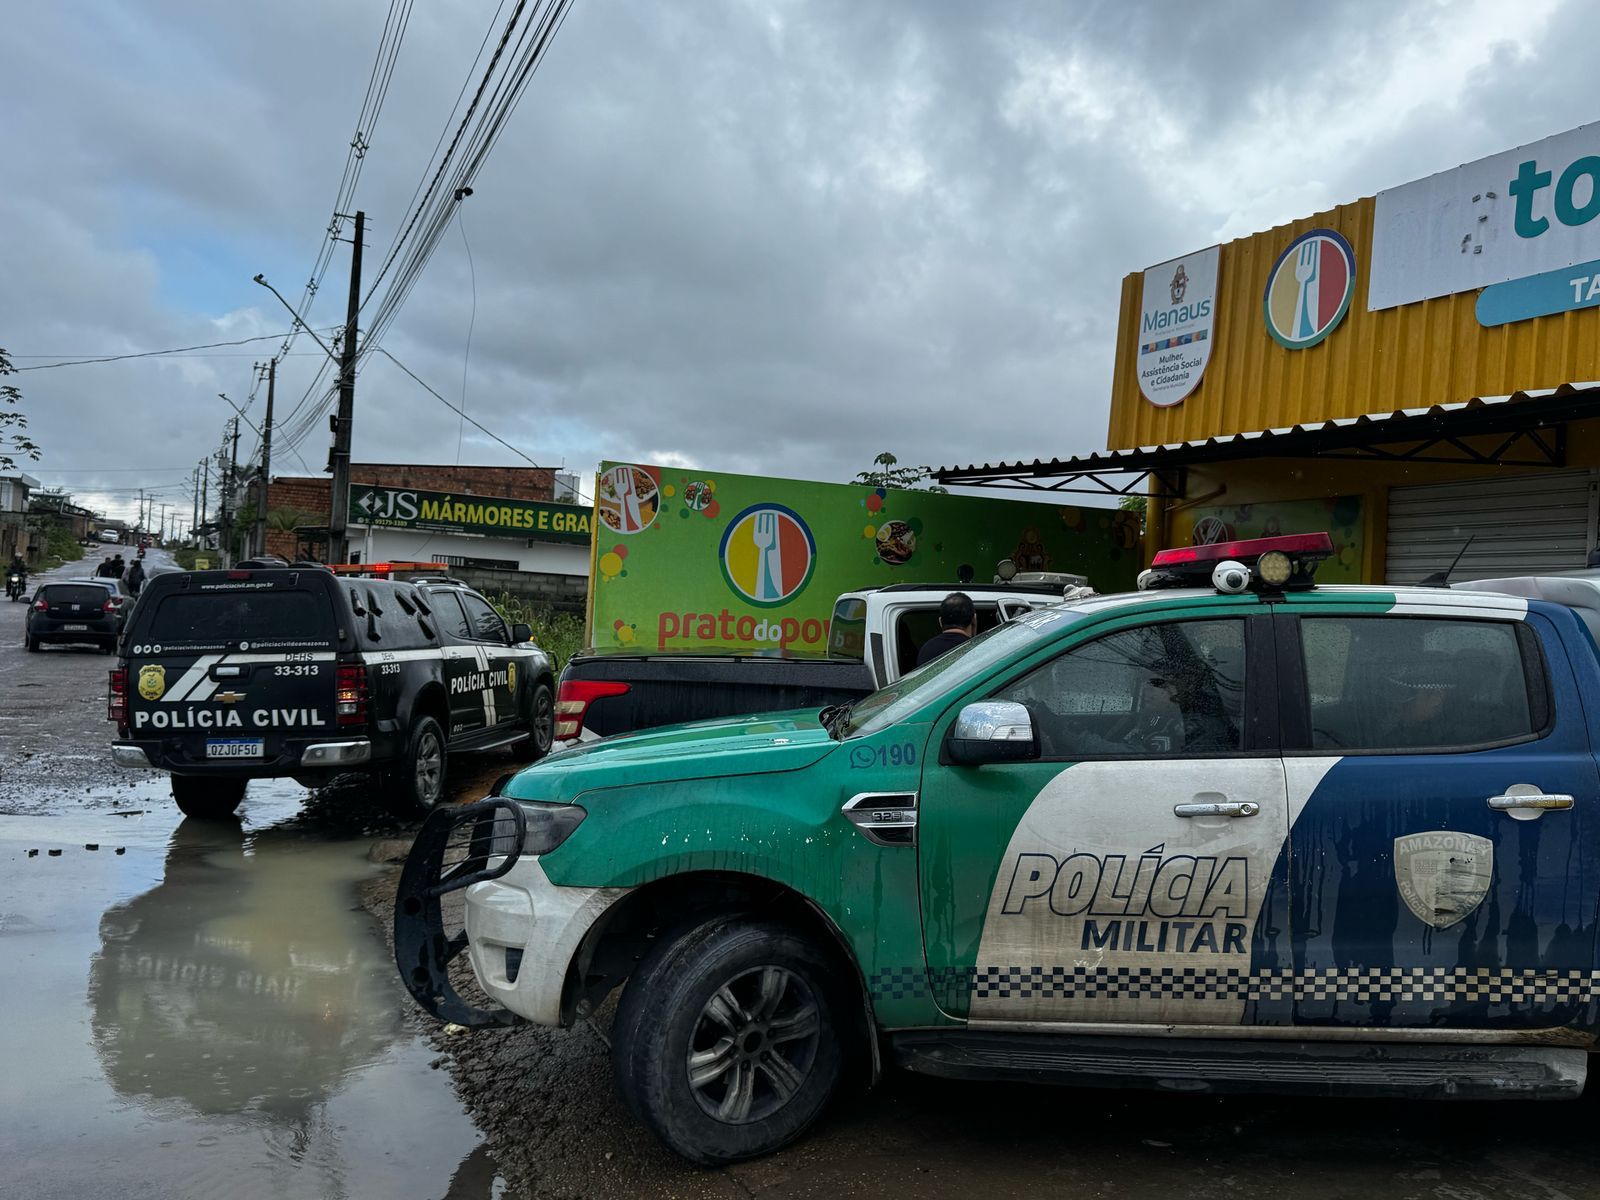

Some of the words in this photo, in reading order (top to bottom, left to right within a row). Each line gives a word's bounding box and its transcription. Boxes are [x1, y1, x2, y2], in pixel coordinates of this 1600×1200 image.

[1509, 156, 1600, 238] to
[1143, 299, 1211, 333] Manaus
[1141, 363, 1180, 378] Assistência
[1180, 357, 1202, 370] Social
[1159, 353, 1184, 364] Mulher,
[1155, 371, 1190, 385] Cidadania
[379, 490, 418, 520] JS
[421, 495, 534, 528] MÁRMORES
[538, 511, 548, 530] E
[552, 512, 592, 533] GRA
[658, 609, 757, 650] prato
[754, 619, 782, 641] do
[274, 665, 319, 676] 33-313
[381, 663, 400, 675] 33-313
[451, 671, 486, 695] POLÍCIA
[488, 670, 508, 687] CIVIL
[135, 706, 243, 729] POLÍCIA
[252, 709, 326, 727] CIVIL
[878, 743, 916, 767] 190
[1001, 843, 1248, 918] POLÍCIA
[1400, 881, 1428, 916] Polícia
[1081, 920, 1248, 953] MILITAR
